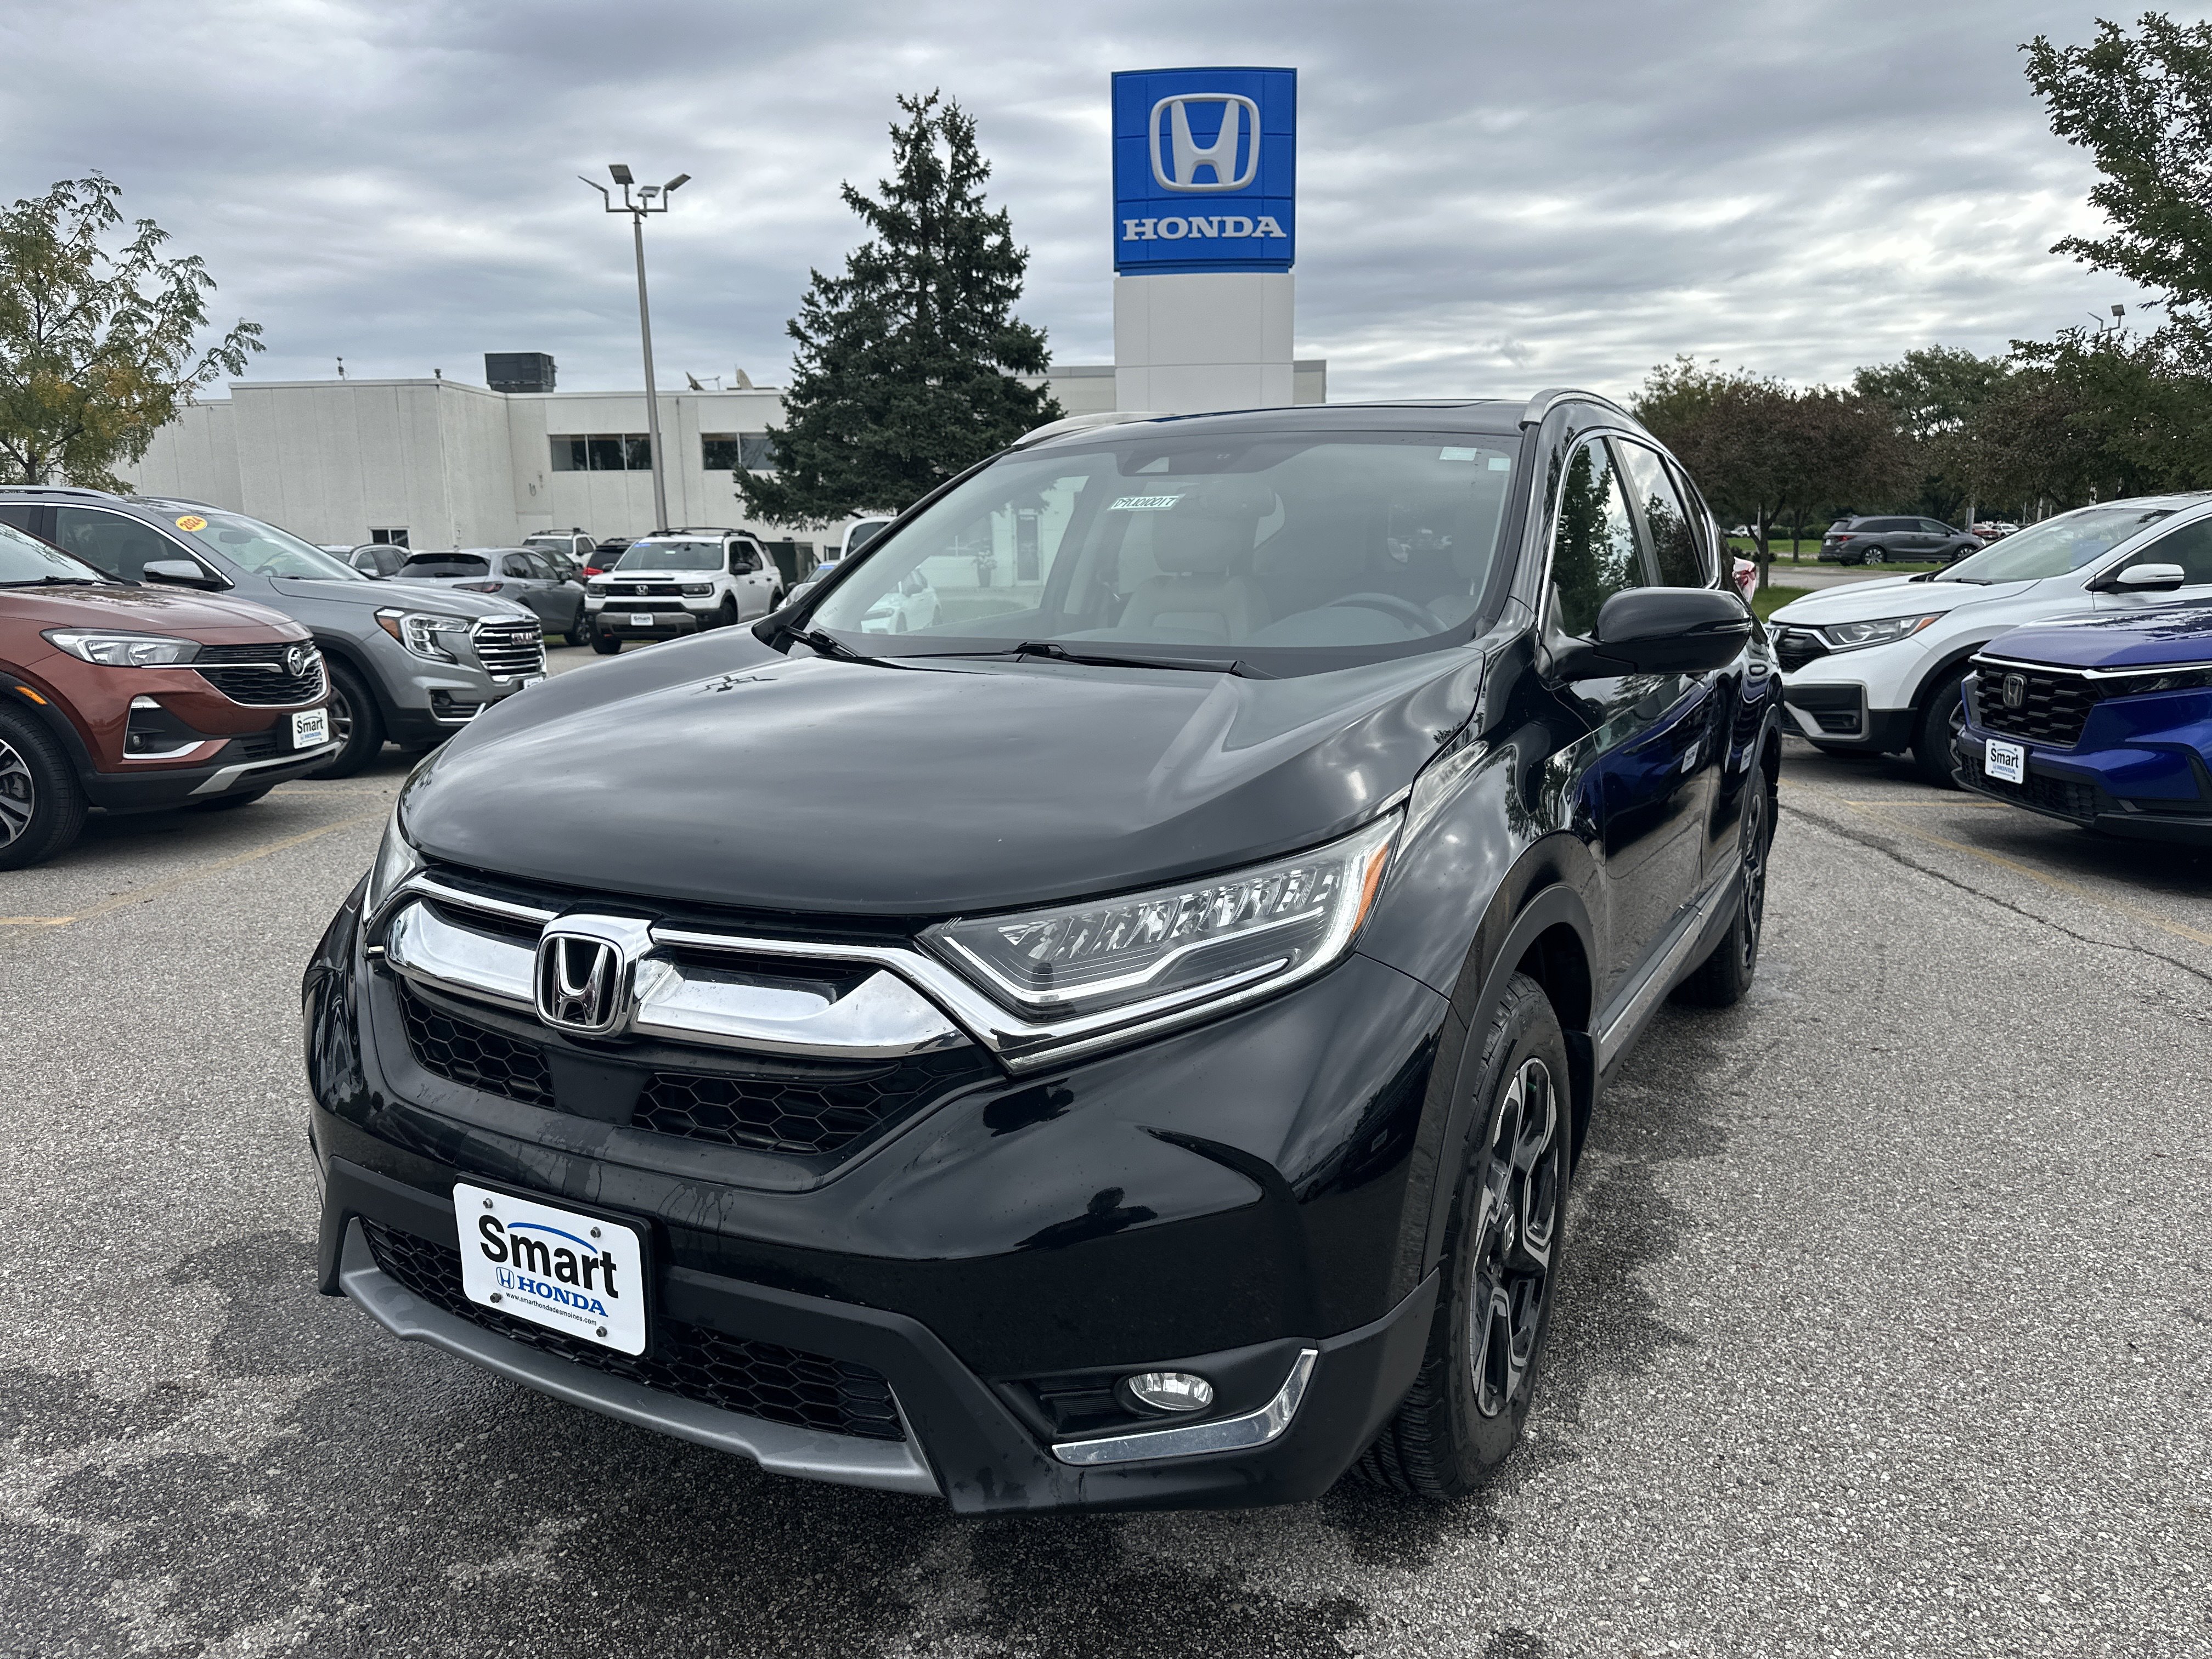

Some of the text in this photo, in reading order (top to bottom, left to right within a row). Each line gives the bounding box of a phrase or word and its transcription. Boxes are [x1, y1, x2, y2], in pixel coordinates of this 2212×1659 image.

[1122, 216, 1287, 241] HONDA
[179, 516, 205, 530] 2024
[297, 716, 323, 734] Smart
[1990, 747, 2019, 768] Smart
[1997, 765, 2016, 775] HONDA
[478, 1215, 619, 1299] Smart
[517, 1276, 609, 1317] HONDA
[506, 1292, 597, 1326] www.smarthondadesmoines.com
